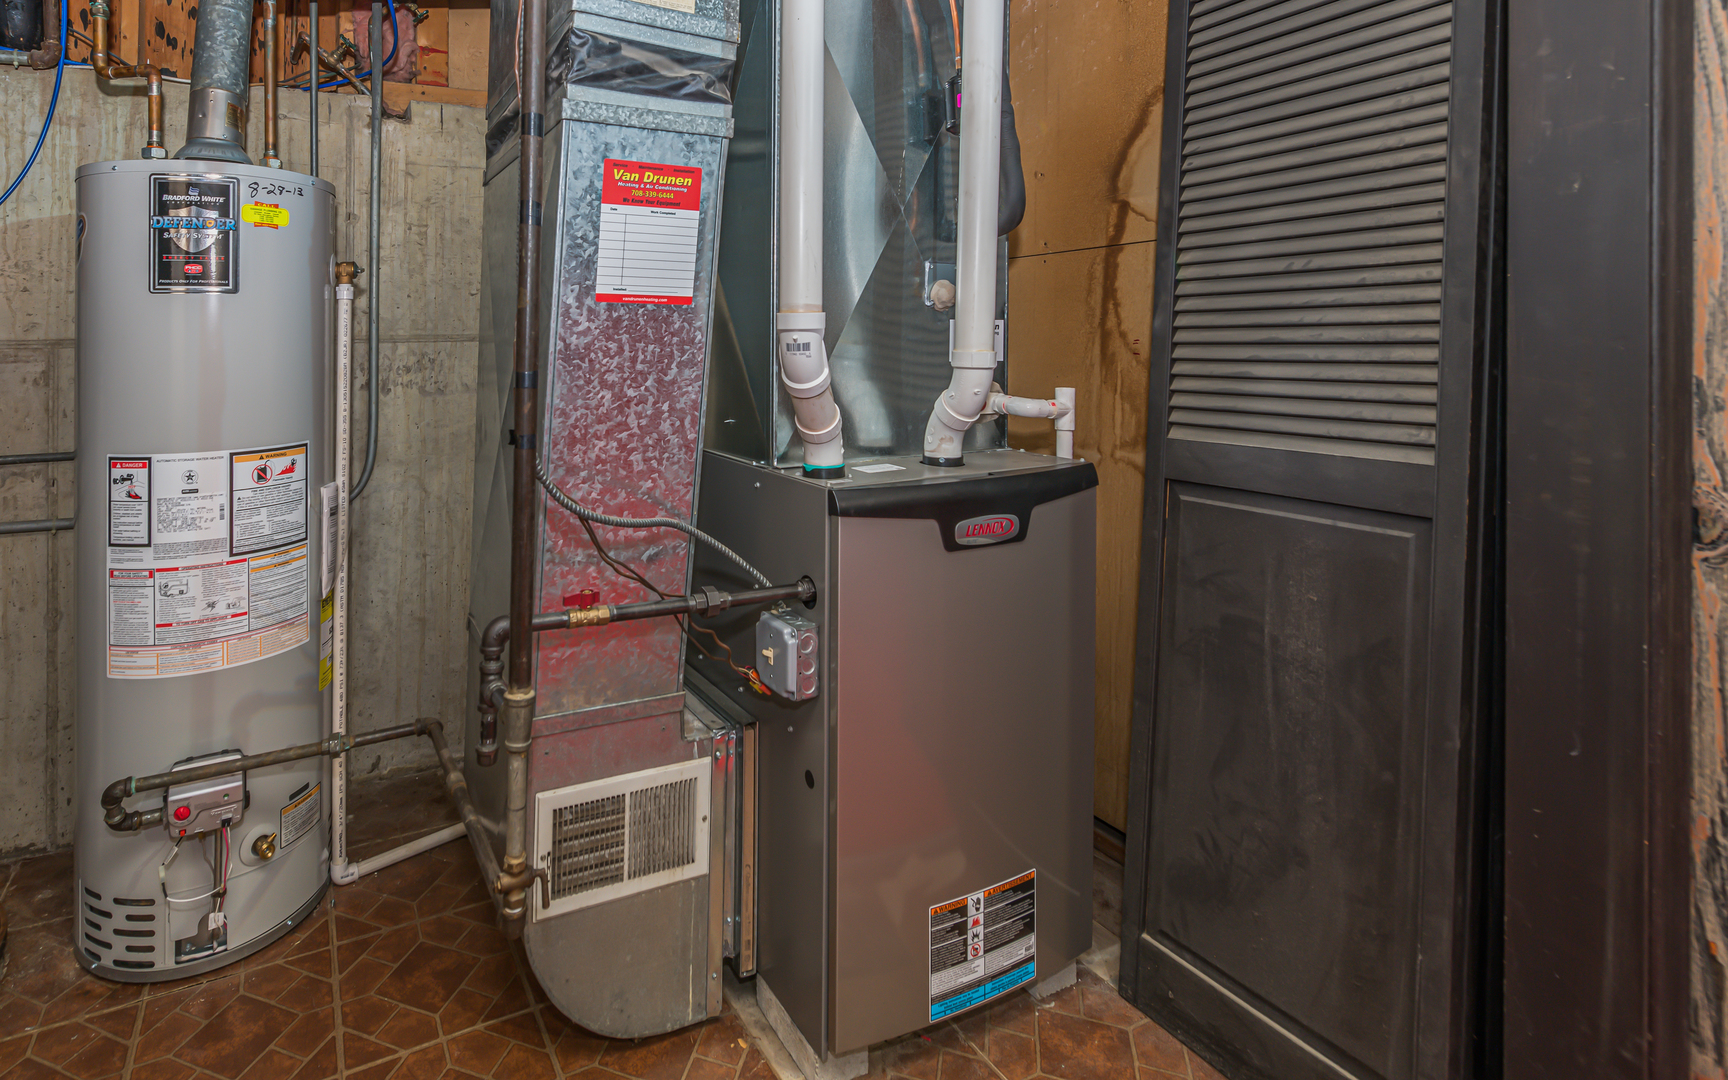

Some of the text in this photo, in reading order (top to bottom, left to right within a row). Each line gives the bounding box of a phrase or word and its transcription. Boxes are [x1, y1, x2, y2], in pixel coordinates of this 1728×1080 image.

[613, 168, 692, 186] Van Drunen
[631, 190, 674, 199] 708-339-6444
[152, 216, 236, 230] DEFENDER
[966, 520, 1006, 537] LENNOX
[992, 873, 1032, 895] AVERTISSEMENT
[940, 899, 966, 914] WARNING
